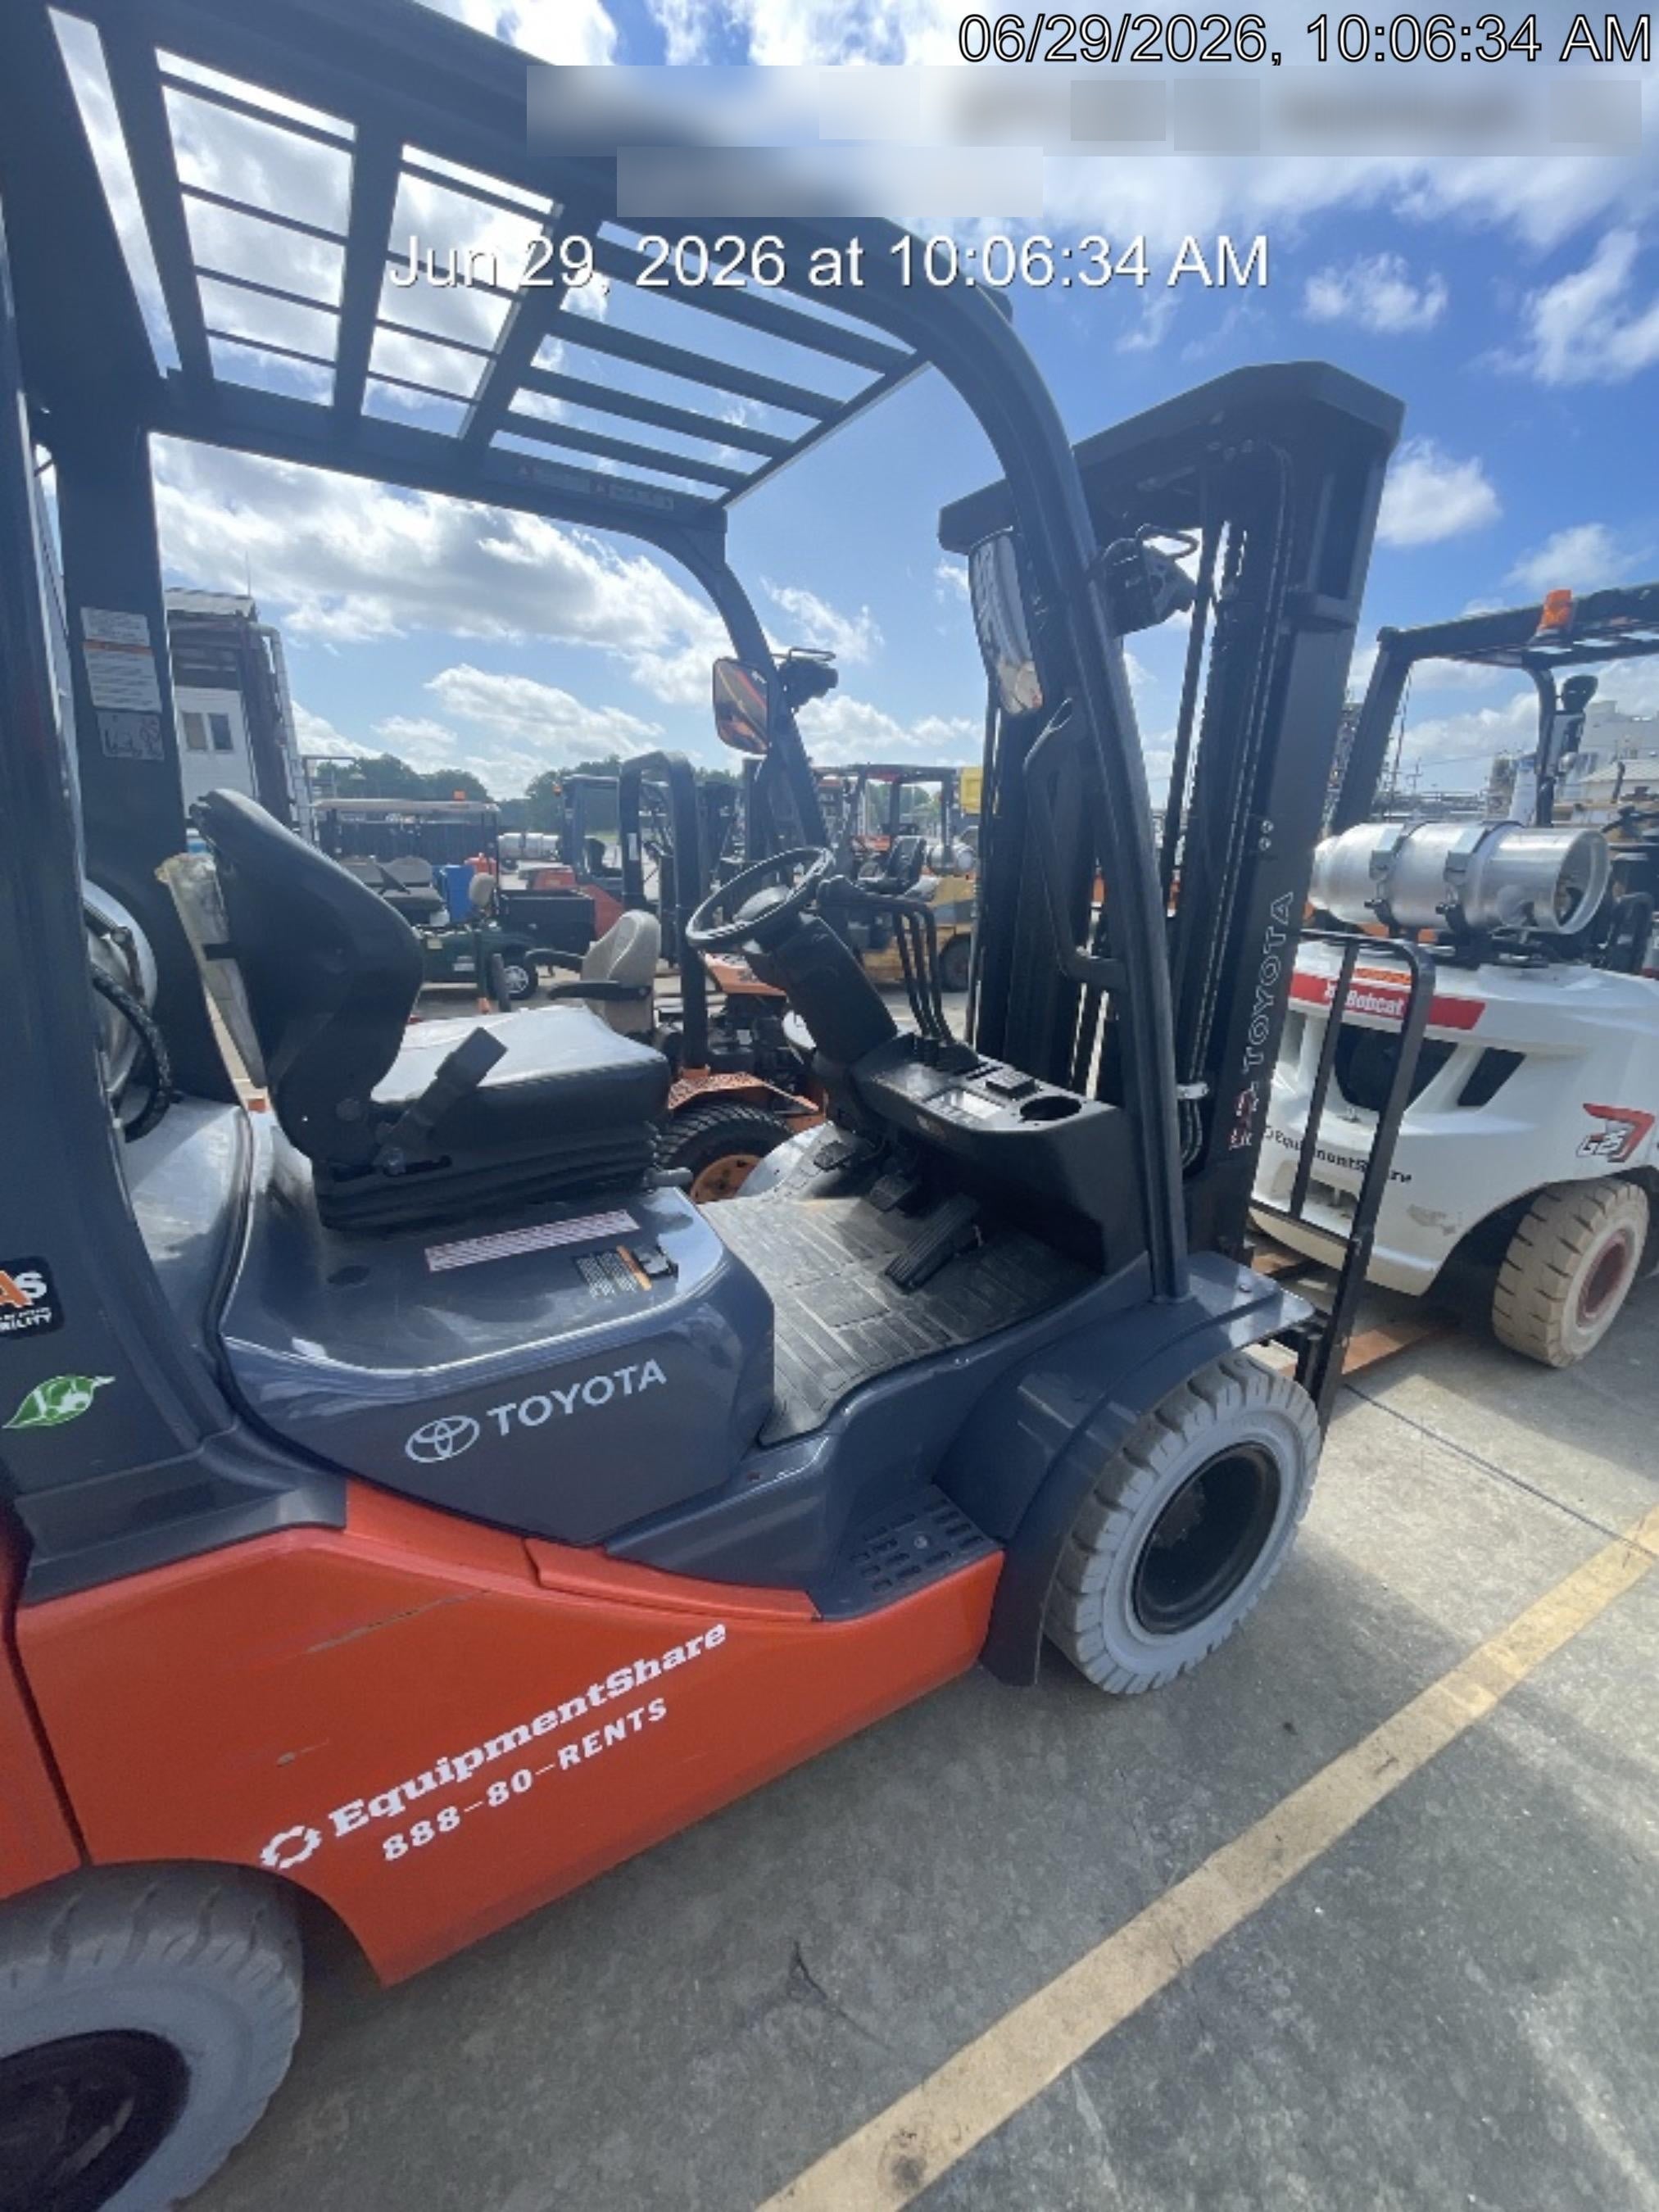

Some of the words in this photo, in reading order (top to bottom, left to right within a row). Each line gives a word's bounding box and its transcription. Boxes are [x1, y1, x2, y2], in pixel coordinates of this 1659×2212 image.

[1241, 891, 1294, 1075] TOYOTA
[1344, 989, 1404, 1018] Bobcat
[487, 1358, 667, 1435] TOYOTA
[328, 1622, 728, 1837] EquipmentShare
[381, 1698, 668, 1861] 888-80-RENTS
